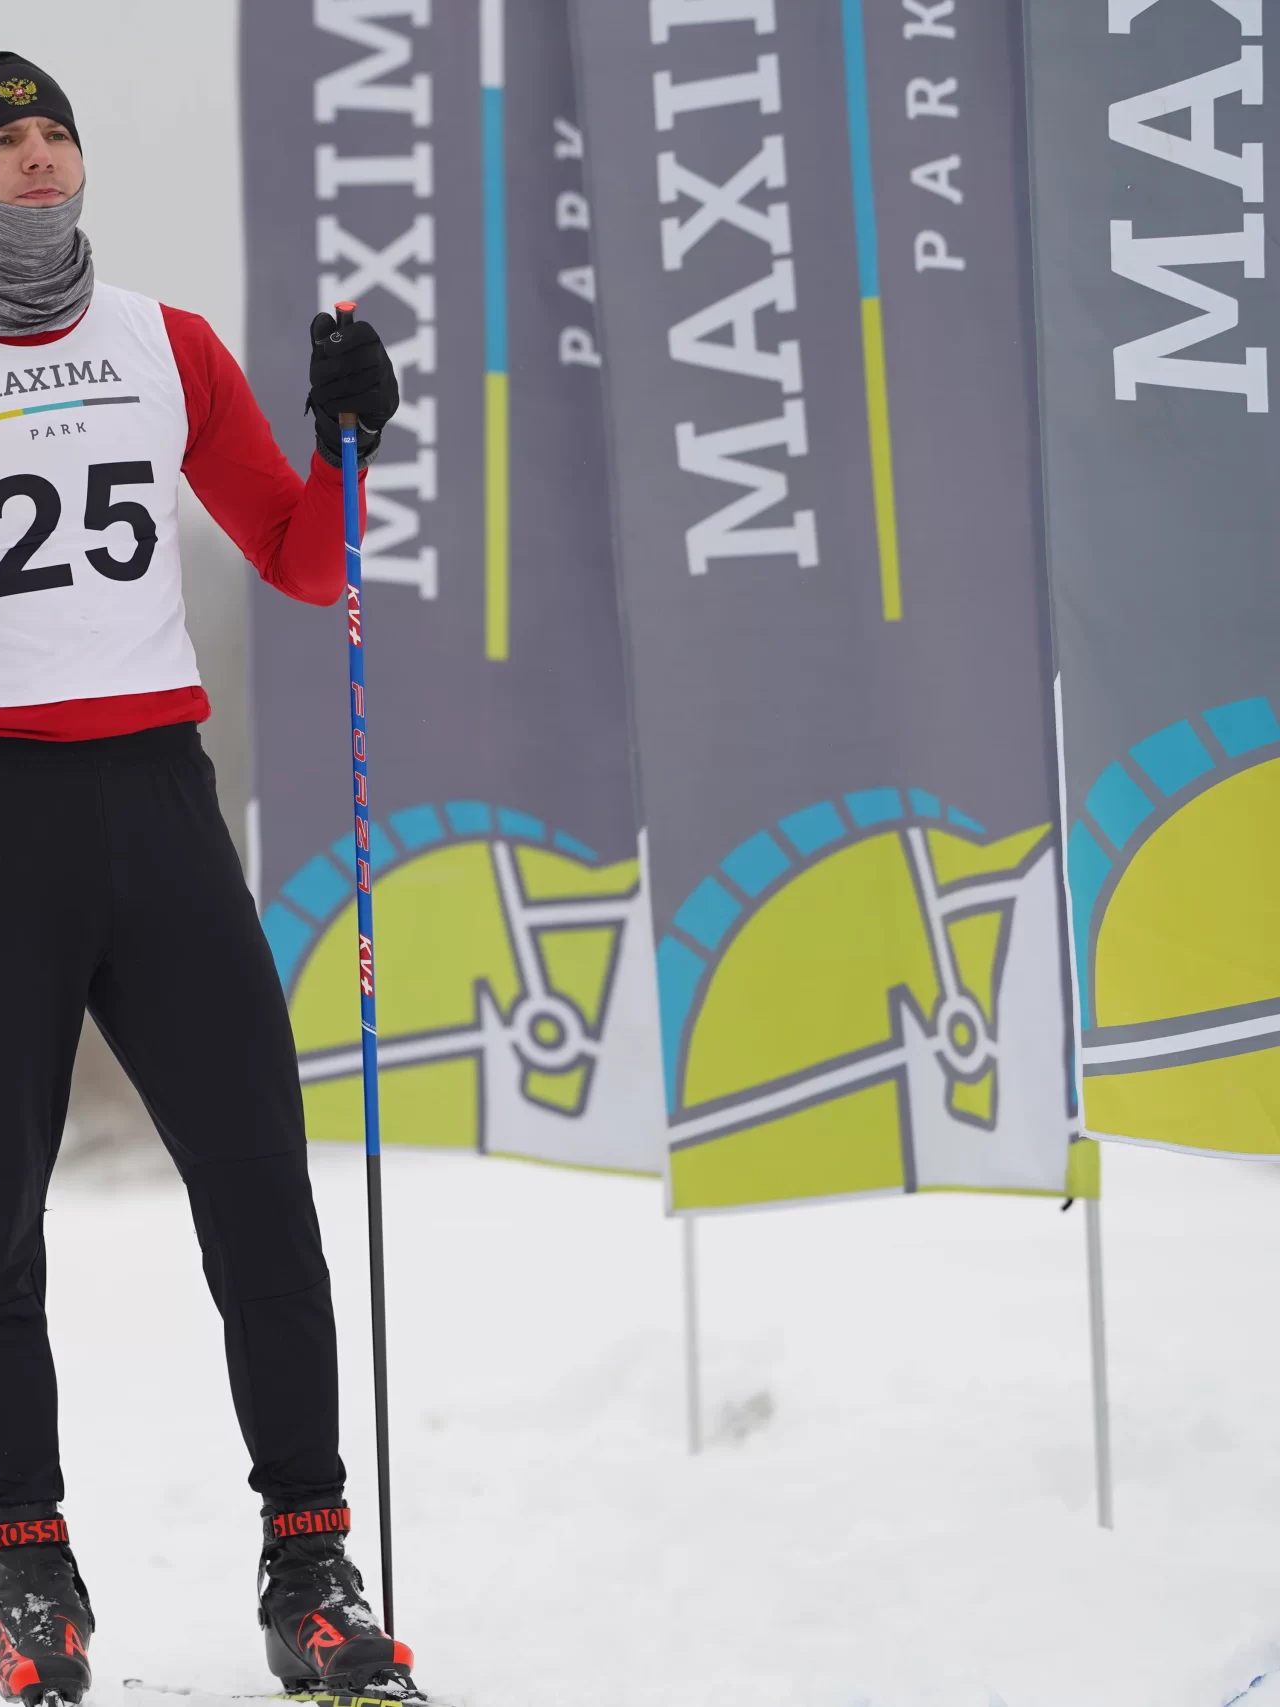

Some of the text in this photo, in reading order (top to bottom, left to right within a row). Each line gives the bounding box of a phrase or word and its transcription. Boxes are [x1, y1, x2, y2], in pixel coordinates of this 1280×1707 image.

[902, 0, 966, 272] PARK
[1107, 0, 1269, 413] MA
[650, 0, 819, 575] MAXI
[29, 421, 87, 441] PARK
[351, 681, 371, 894] FORZA
